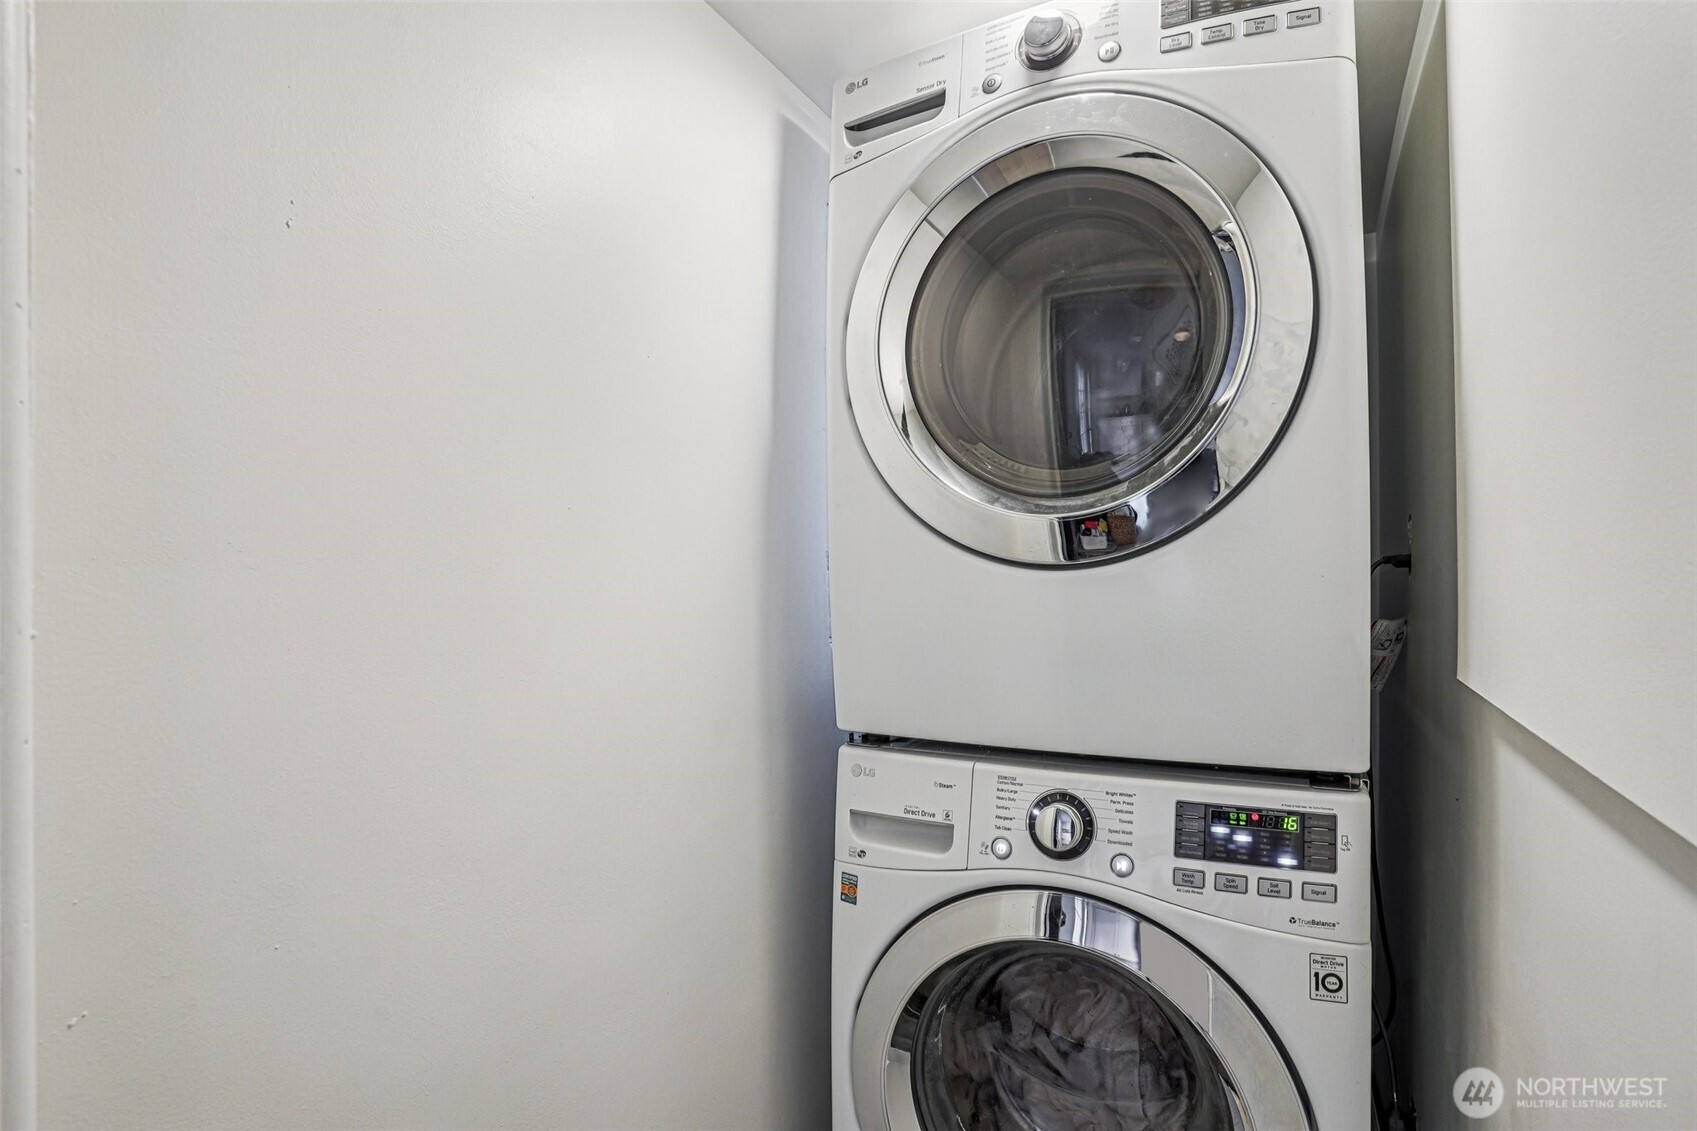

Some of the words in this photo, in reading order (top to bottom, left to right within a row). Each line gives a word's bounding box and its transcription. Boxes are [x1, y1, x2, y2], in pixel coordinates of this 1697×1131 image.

[1295, 13, 1312, 21] Signal
[856, 77, 869, 89] LG
[915, 83, 935, 94] Sensor
[936, 79, 947, 87] Dry
[863, 767, 876, 778] LG
[903, 807, 920, 817] Direct
[920, 809, 936, 819] Drive
[1283, 817, 1297, 831] 16
[1107, 827, 1121, 835] Speed
[1106, 838, 1134, 847] Downloaded
[1181, 872, 1196, 880] Wash
[1223, 882, 1239, 890] Speed
[1267, 887, 1281, 895] Level
[1310, 888, 1327, 896] Signal
[1312, 958, 1329, 966] Direct
[1329, 960, 1345, 968] Drive
[1313, 971, 1344, 994] 10
